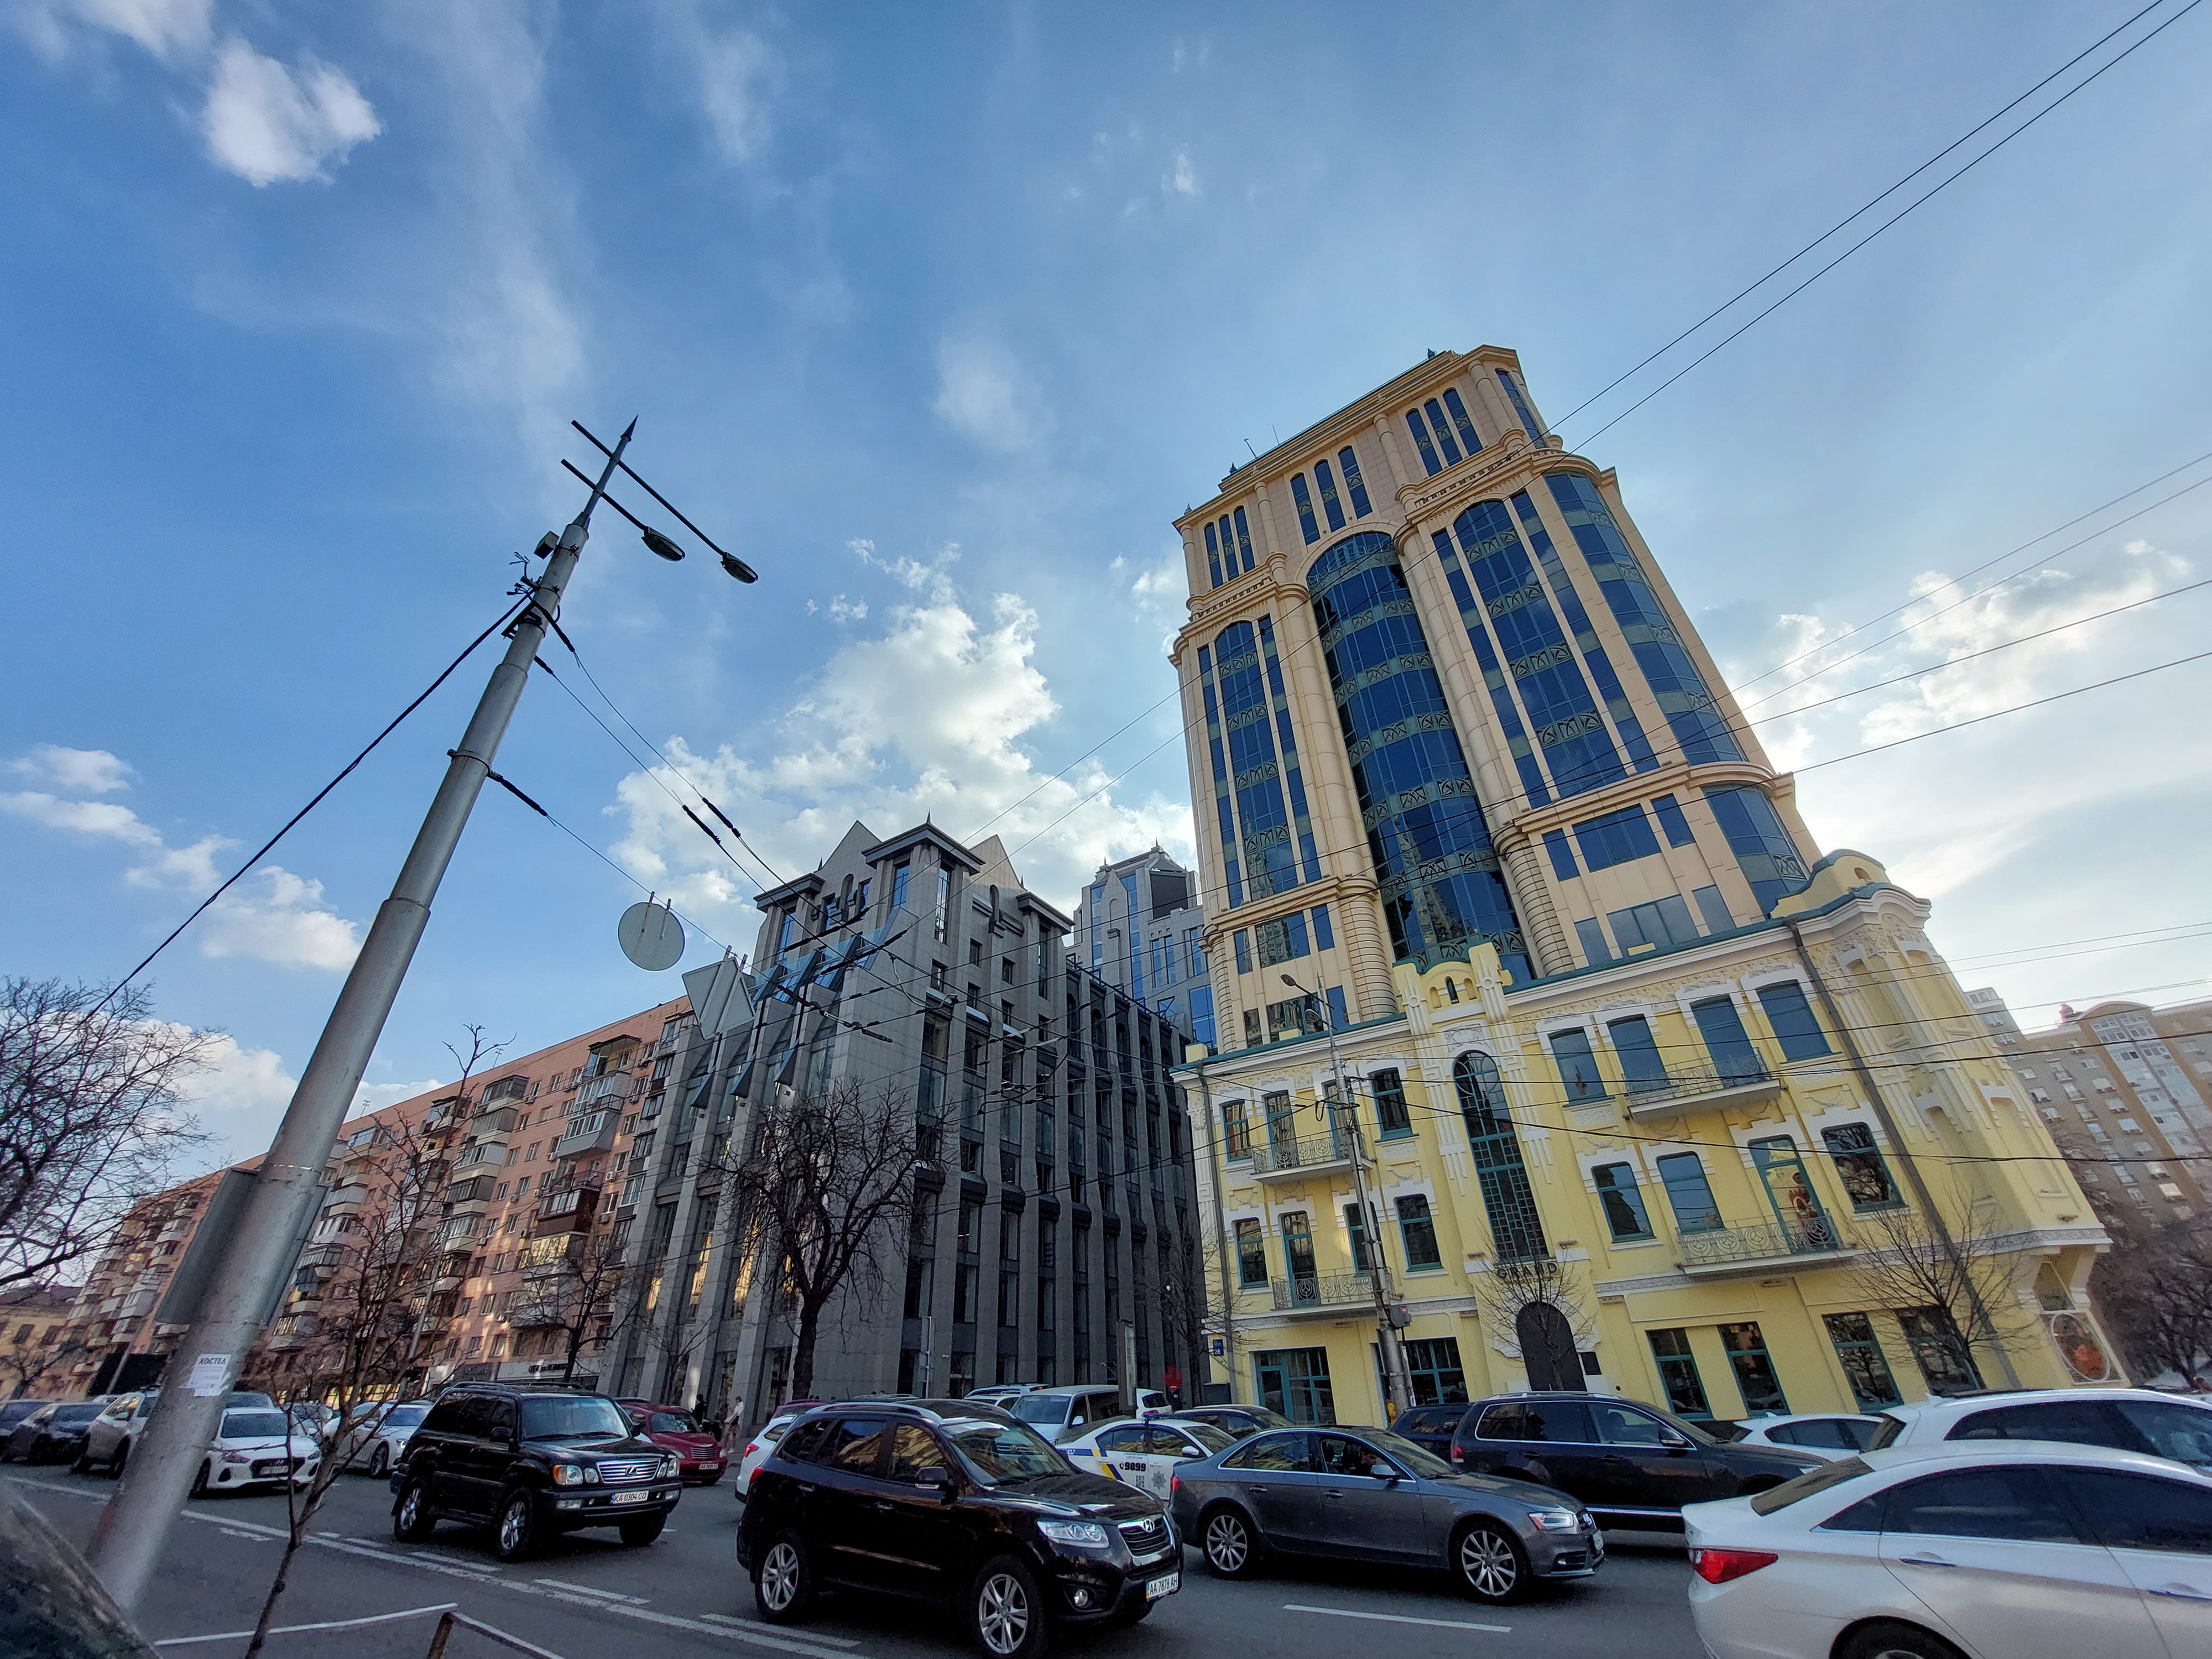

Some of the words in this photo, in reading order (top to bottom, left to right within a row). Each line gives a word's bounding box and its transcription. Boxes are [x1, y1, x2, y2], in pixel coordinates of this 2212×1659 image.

[1497, 1261, 1557, 1280] GRAND
[1125, 1462, 1146, 1472] 9899
[1150, 1583, 1157, 1595] AA
[1159, 1578, 1170, 1592] 7878
[1171, 1575, 1177, 1588] AH
